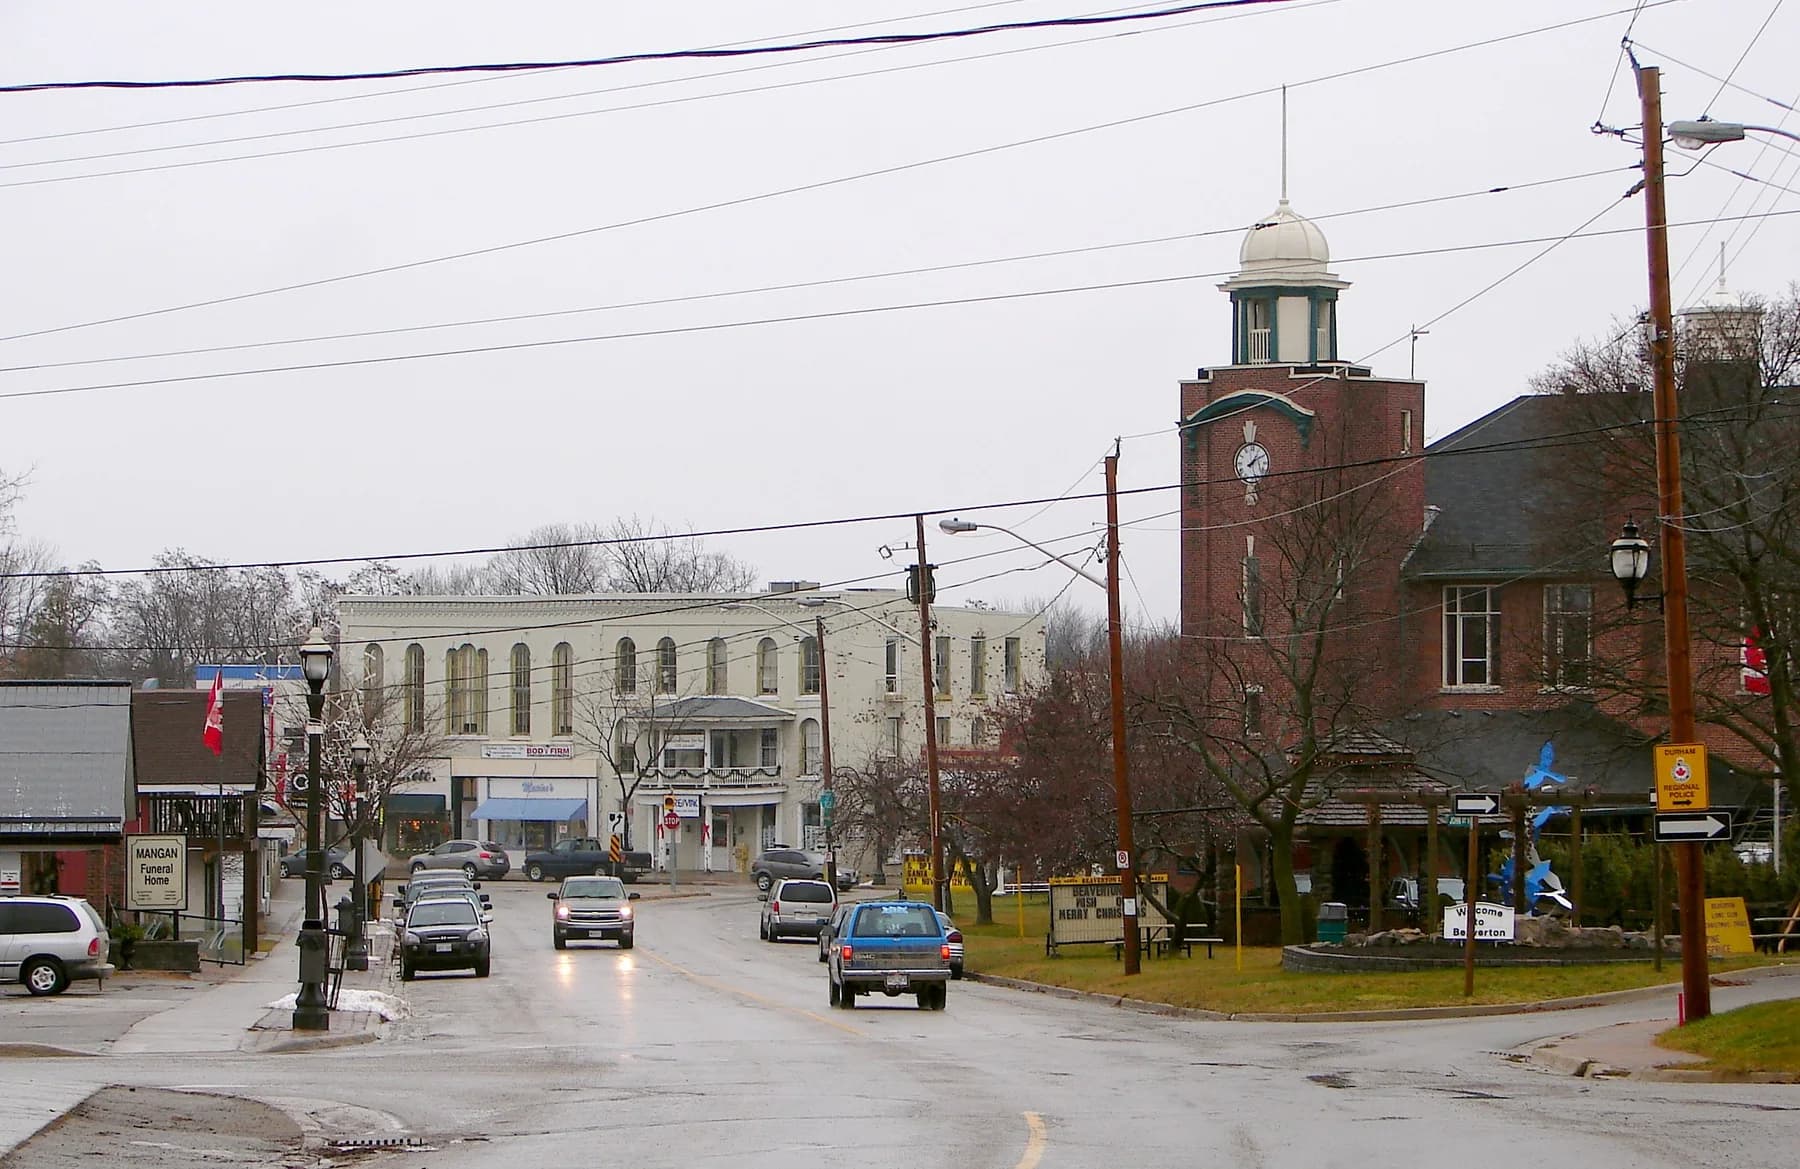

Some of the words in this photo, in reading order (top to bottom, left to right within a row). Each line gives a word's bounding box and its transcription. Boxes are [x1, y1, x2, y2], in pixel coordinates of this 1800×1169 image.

[1664, 748, 1696, 756] DURHAM
[664, 817, 680, 825] STOP
[136, 848, 178, 859] MANGAN
[140, 863, 174, 874] Funeral
[144, 875, 170, 885] Home
[1059, 908, 1089, 920] MERRY
[1096, 906, 1147, 919] CHRISAS
[1456, 907, 1503, 917] Wcome
[1453, 928, 1506, 936] Beverton
